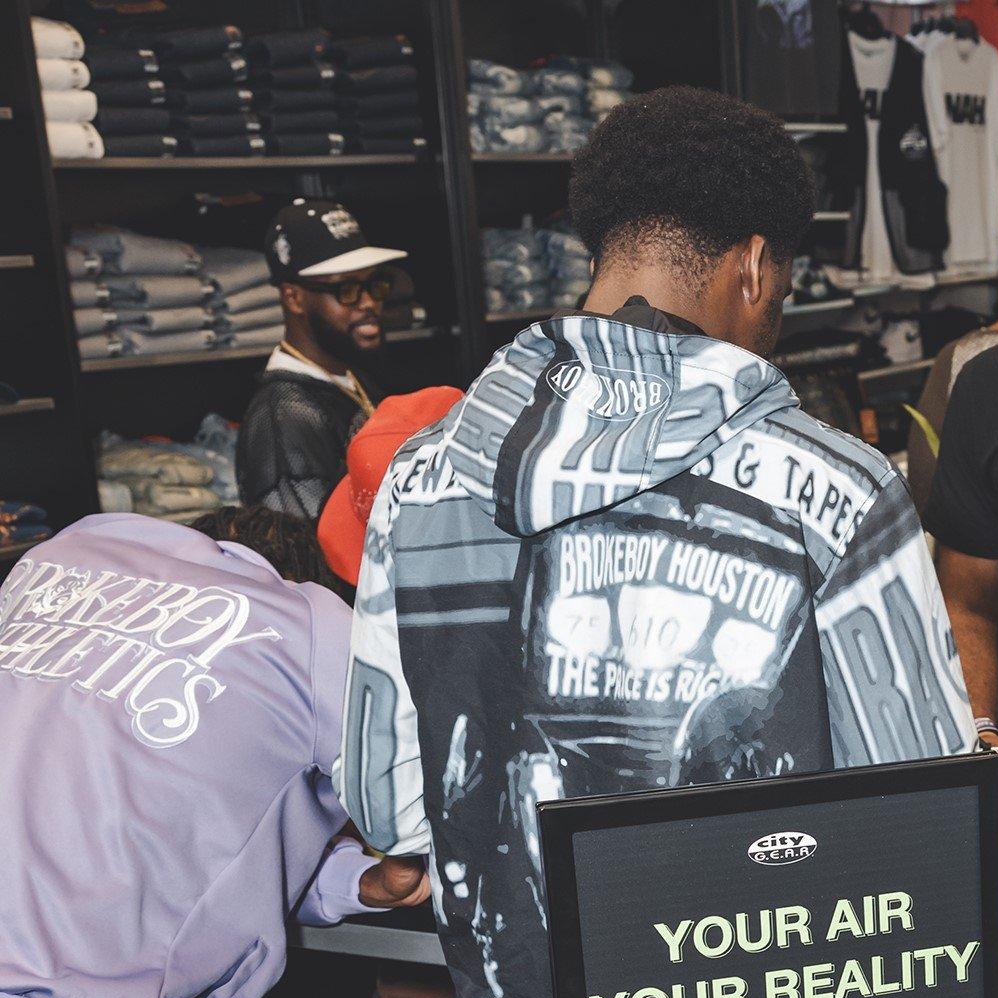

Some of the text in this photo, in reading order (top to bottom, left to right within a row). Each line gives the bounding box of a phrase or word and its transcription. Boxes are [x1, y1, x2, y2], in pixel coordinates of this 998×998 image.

[551, 364, 662, 417] BROKOY
[560, 534, 796, 631] BROKEBOY HOUSTON
[0, 622, 226, 749] THLETICS
[546, 642, 600, 697] THE
[645, 670, 673, 700] IS
[675, 668, 727, 701] RIG
[757, 835, 805, 848] city
[653, 891, 916, 963] YOUR AIR
